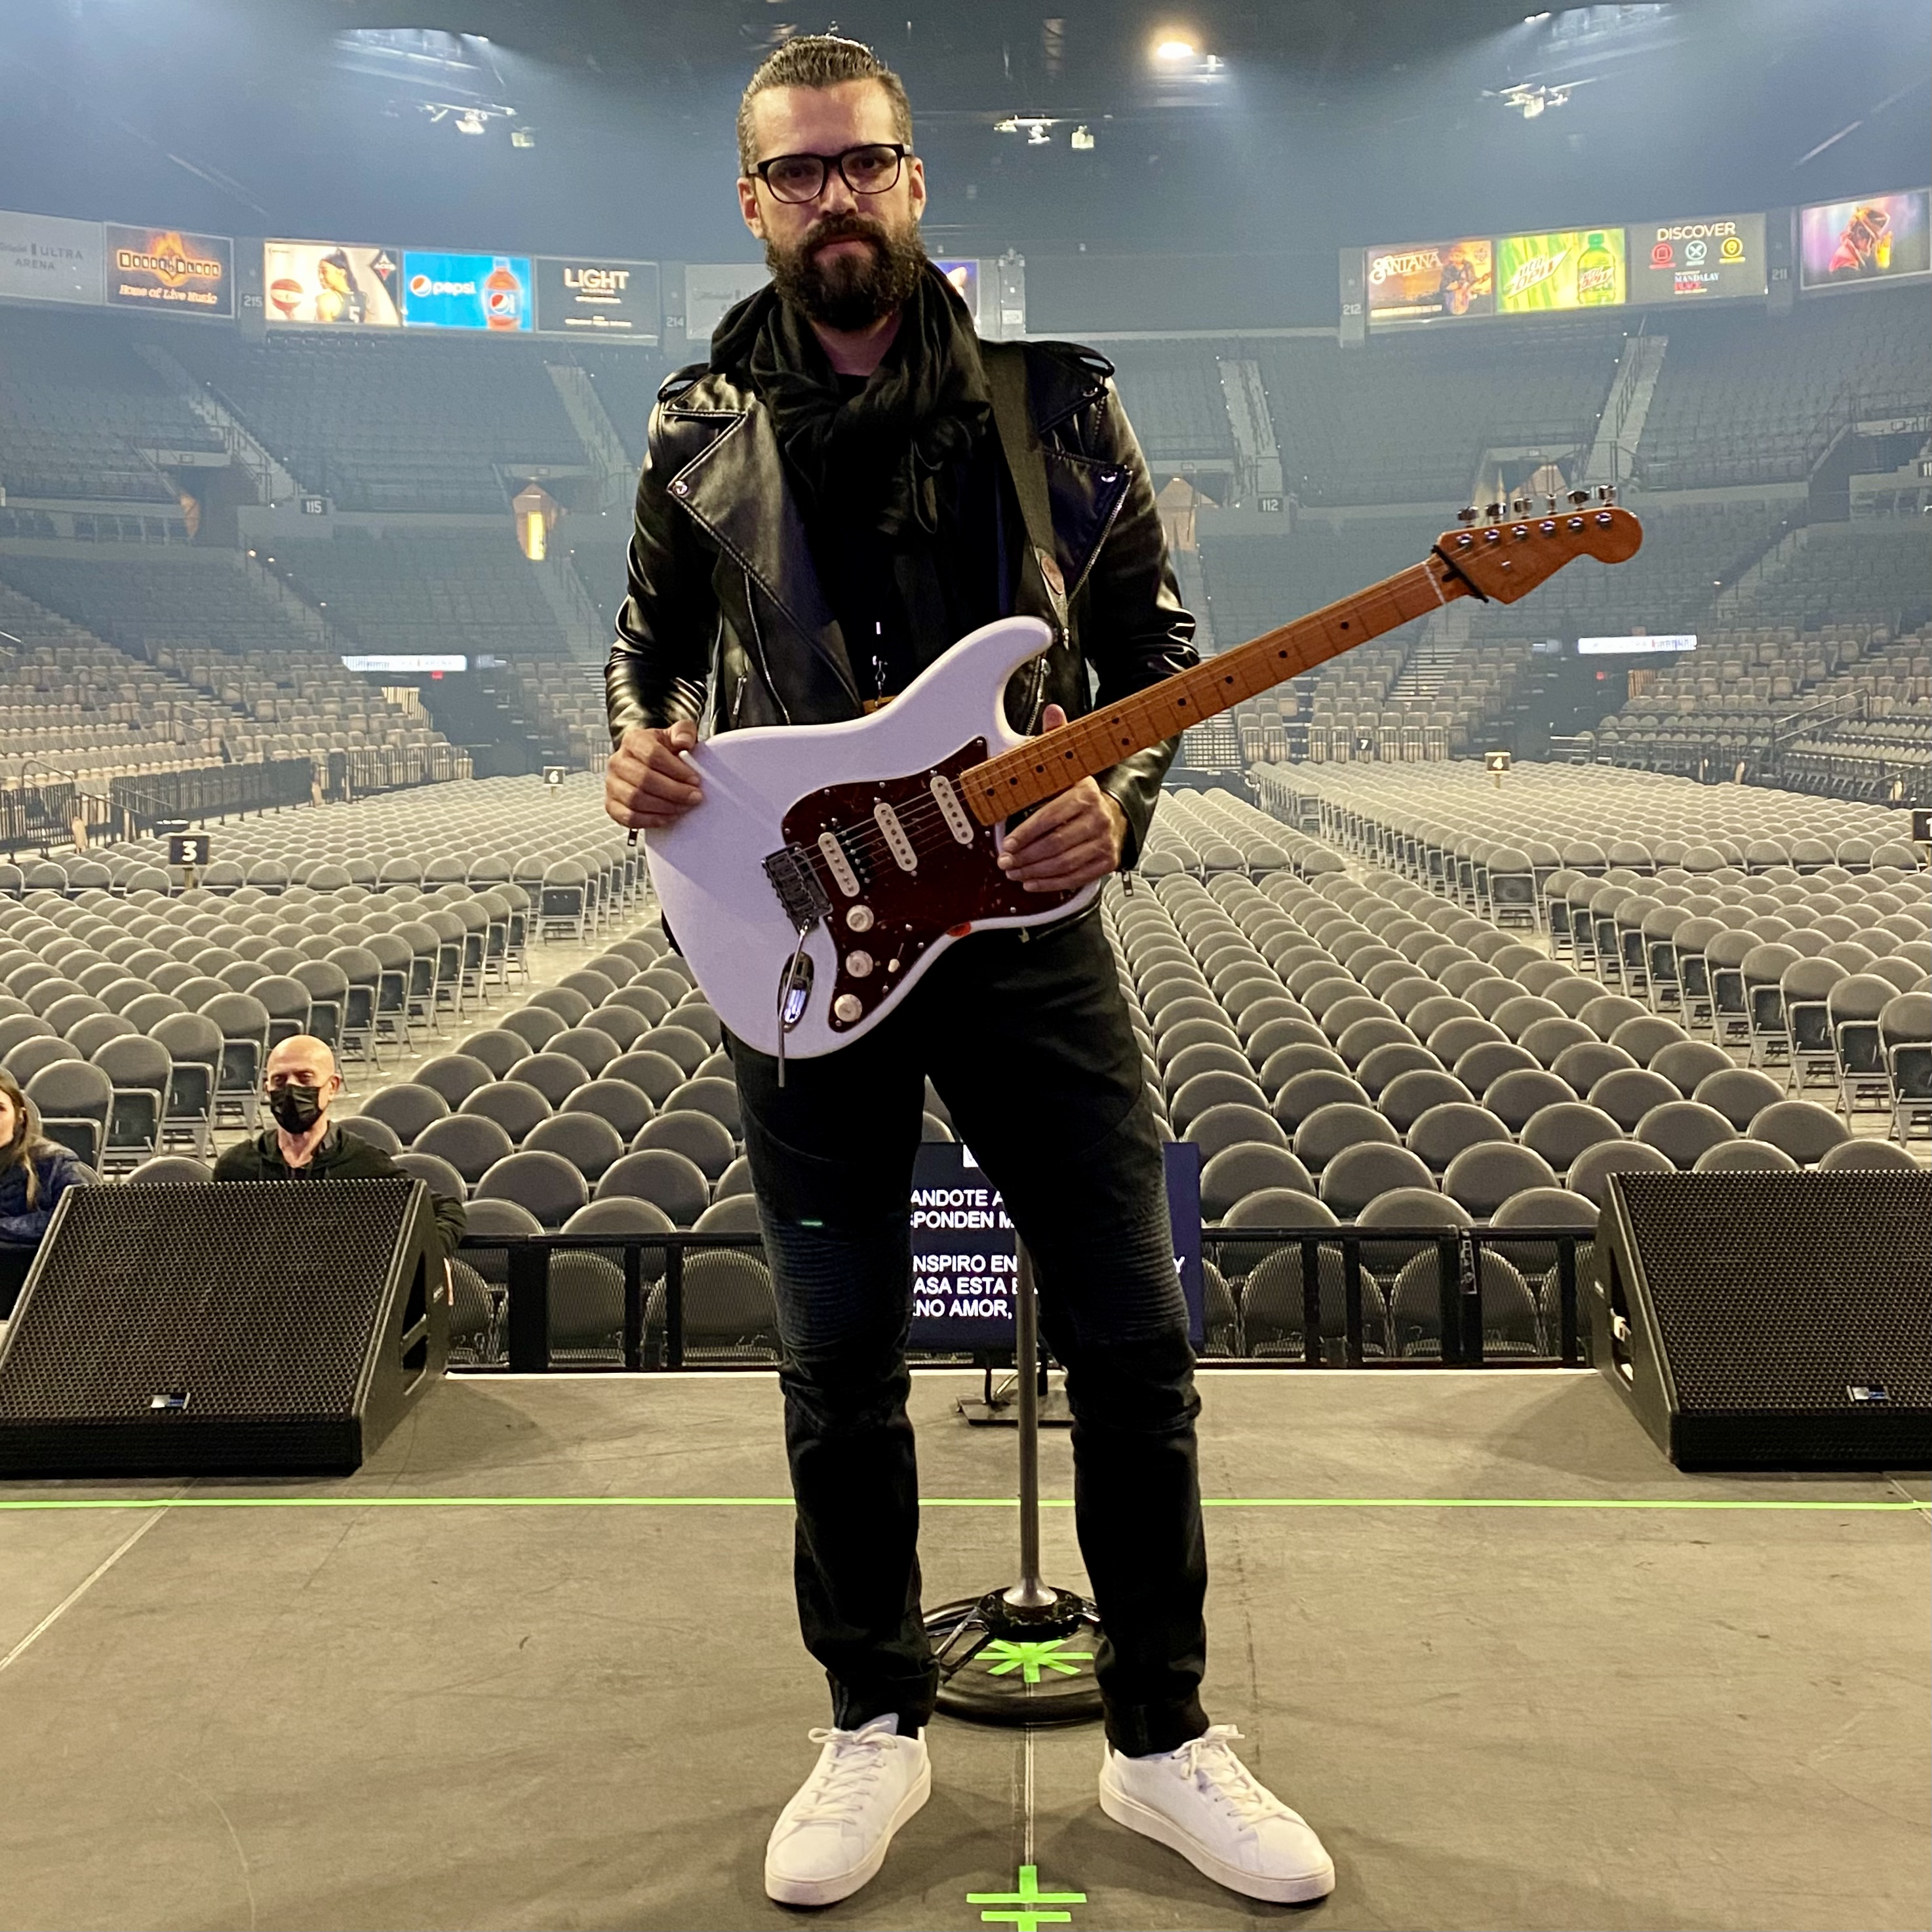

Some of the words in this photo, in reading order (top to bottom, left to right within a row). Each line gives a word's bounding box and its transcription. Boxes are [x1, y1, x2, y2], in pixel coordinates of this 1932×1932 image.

[1657, 222, 1736, 242] DISCOVER
[40, 245, 83, 260] ULTRA
[14, 258, 56, 270] ARENA
[1369, 250, 1444, 285] SANTANA
[564, 267, 629, 289] LIGHT
[1674, 272, 1720, 283] MANDALAY
[1771, 269, 1788, 281] 211
[148, 287, 163, 299] of
[163, 289, 186, 301] Live
[187, 292, 218, 304] Music
[433, 281, 477, 296] pepsi
[243, 295, 262, 307] 215
[349, 306, 360, 323] 5
[1343, 304, 1361, 314] 212
[666, 317, 684, 326] 214
[306, 500, 322, 513] 115
[1262, 499, 1279, 511] 112
[1360, 739, 1368, 750] 7
[1493, 757, 1503, 770] 4
[550, 770, 559, 783] 6
[182, 840, 197, 861] 3
[911, 1189, 988, 1206] ANDOTE
[911, 1211, 994, 1229] PONDEN
[913, 1255, 986, 1272] NSPIRO
[913, 1277, 953, 1295] ASA
[956, 1277, 1007, 1295] ESTA
[913, 1299, 945, 1317] NO
[949, 1299, 1012, 1320] AMOR,
